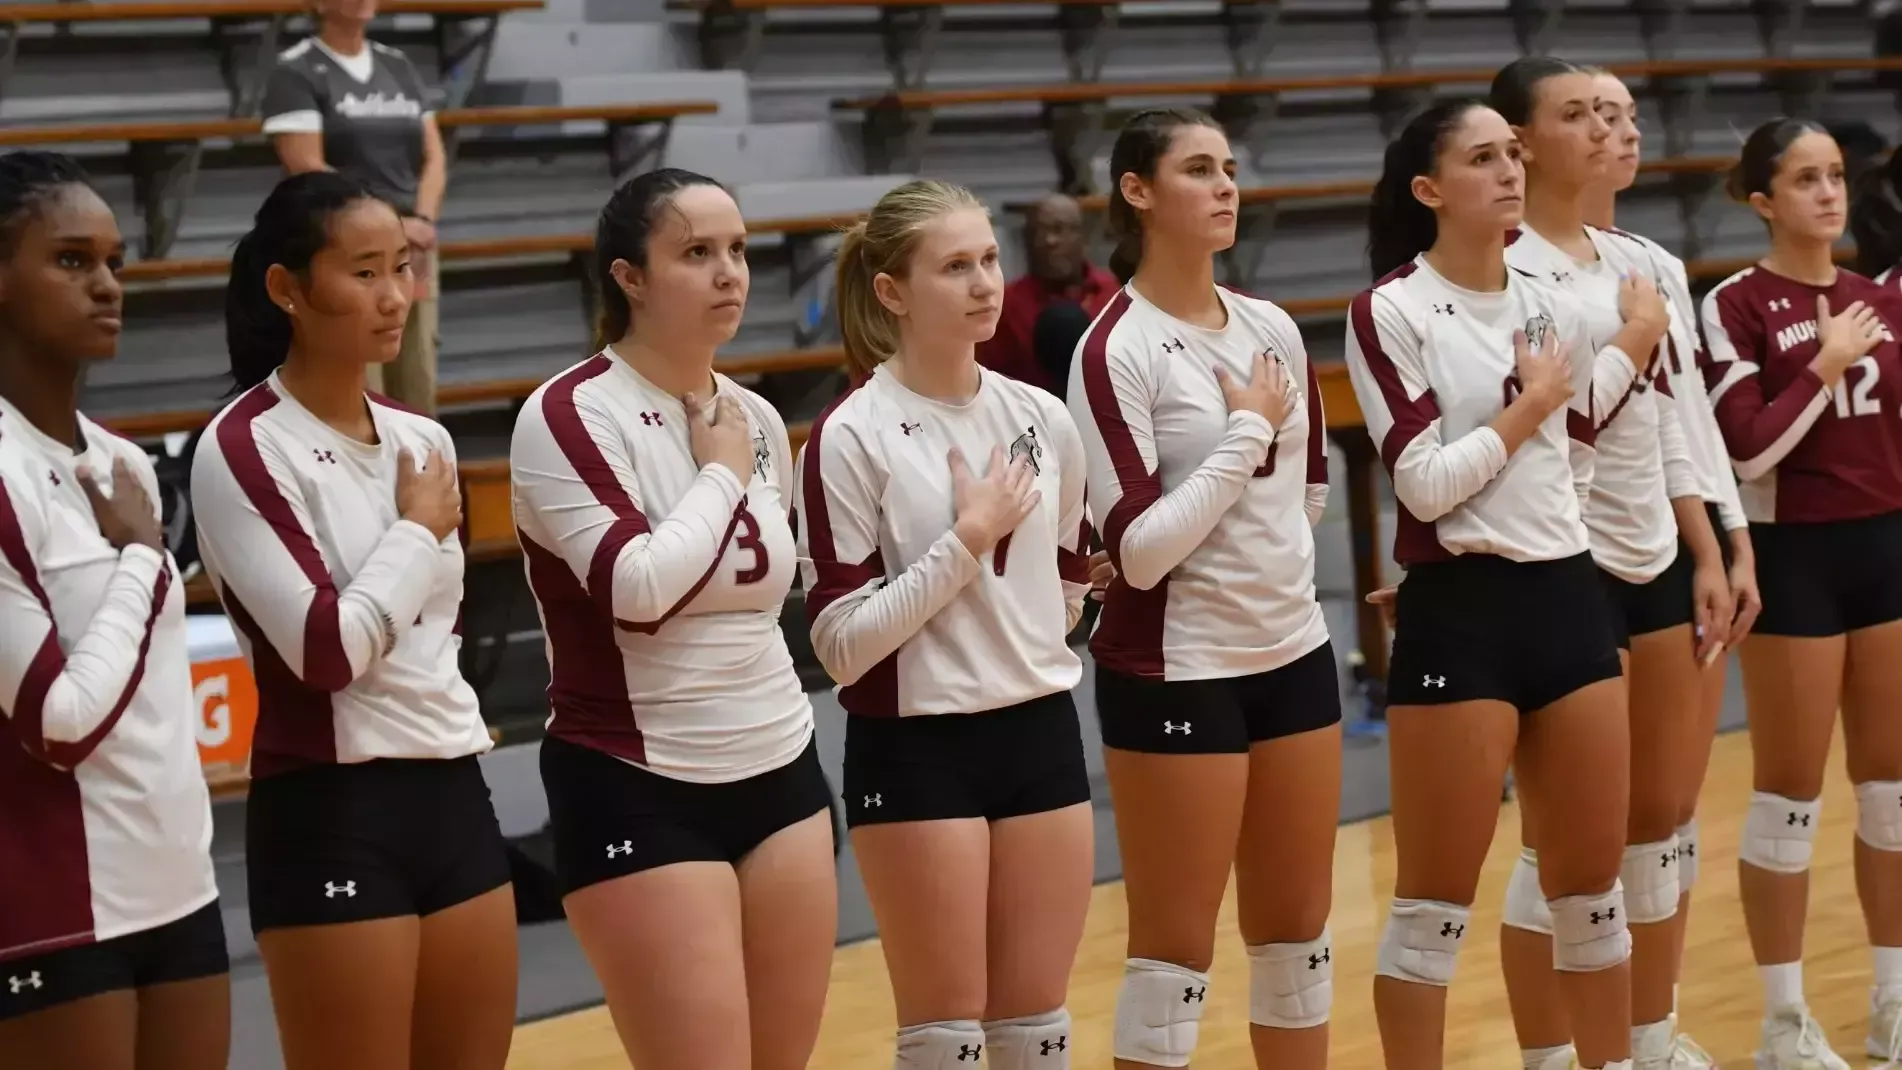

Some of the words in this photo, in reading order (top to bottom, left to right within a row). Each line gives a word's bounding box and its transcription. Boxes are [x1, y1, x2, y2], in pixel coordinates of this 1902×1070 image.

[1833, 355, 1881, 419] 12
[735, 507, 769, 586] 3
[193, 673, 231, 748] G
